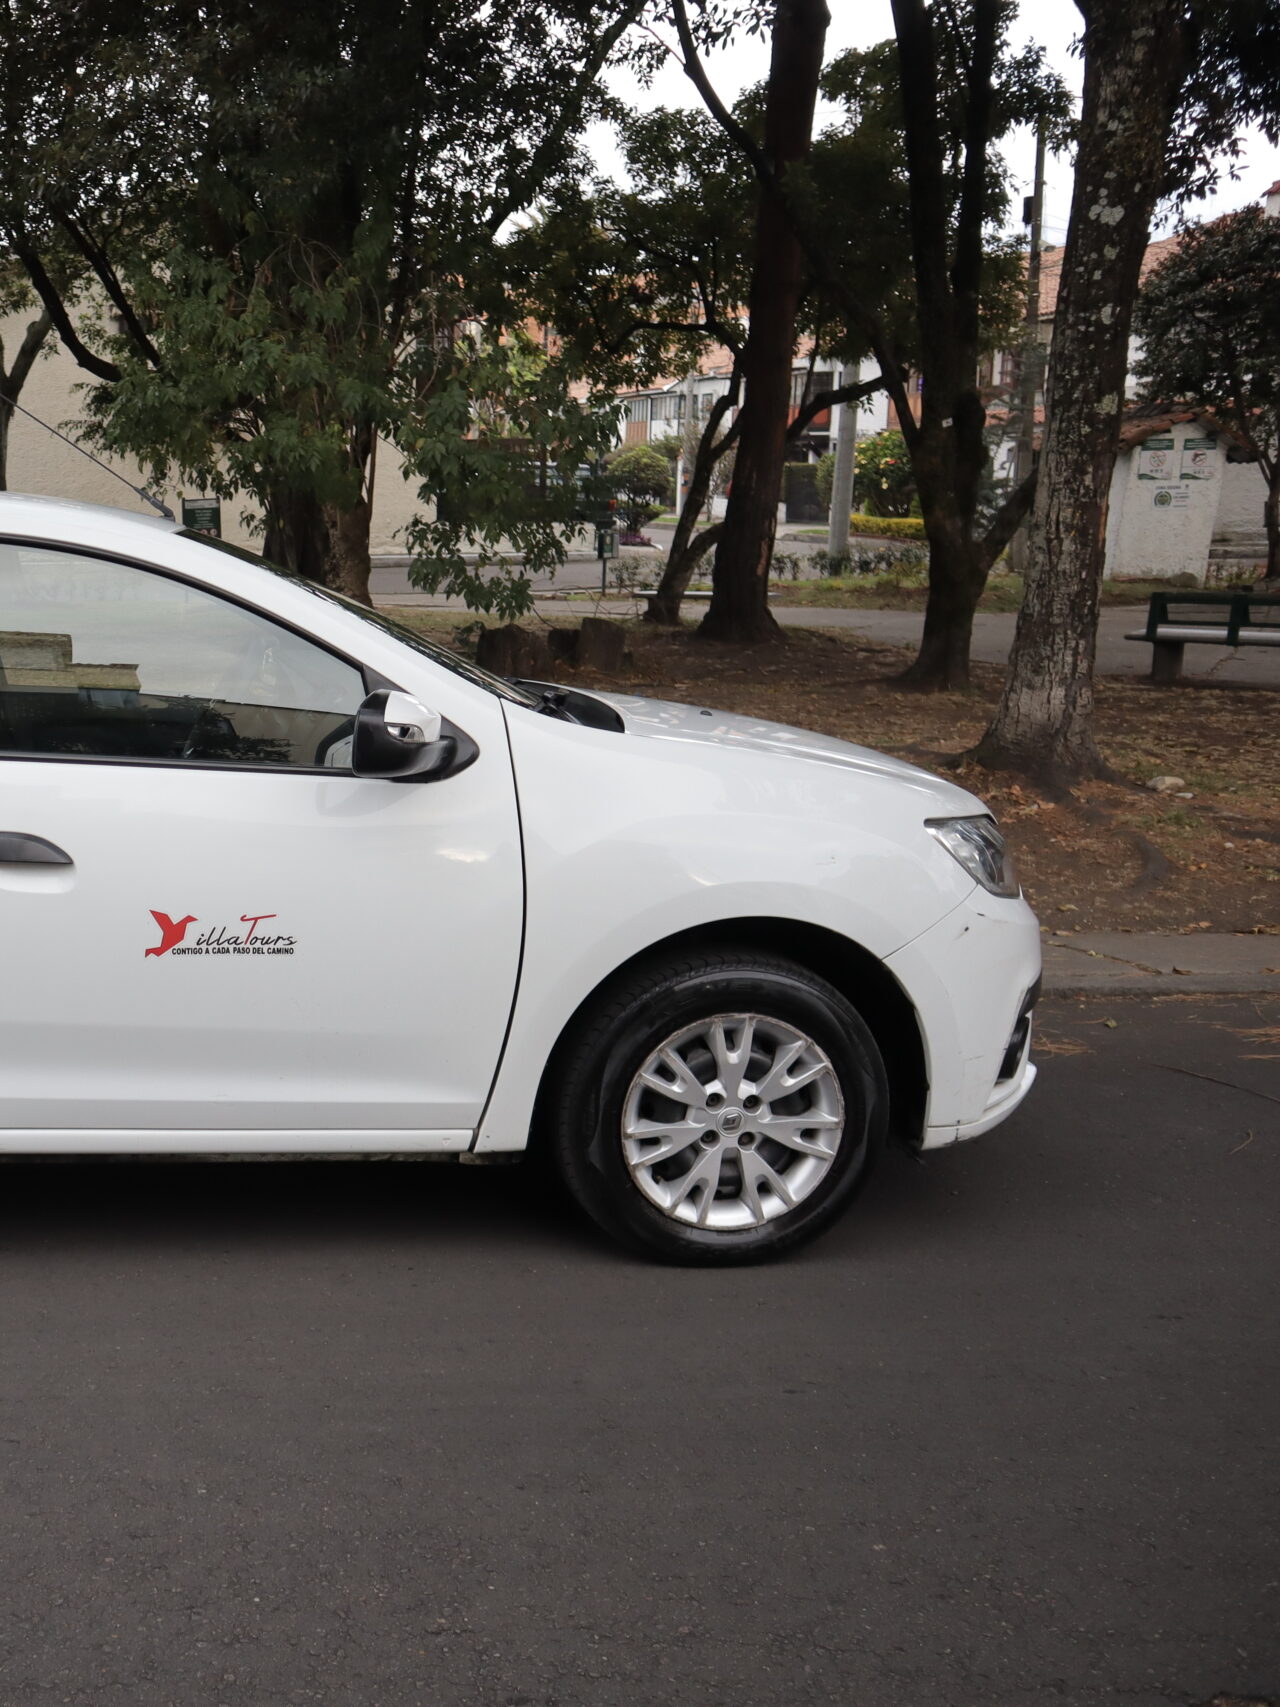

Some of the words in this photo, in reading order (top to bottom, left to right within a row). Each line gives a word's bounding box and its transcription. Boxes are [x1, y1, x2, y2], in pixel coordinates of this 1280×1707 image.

[171, 947, 203, 955] CONTIGO
[204, 947, 210, 955] A
[211, 947, 231, 955] CADA
[233, 946, 251, 955] PASO
[252, 947, 265, 955] DEL
[267, 947, 294, 955] CAMINO
